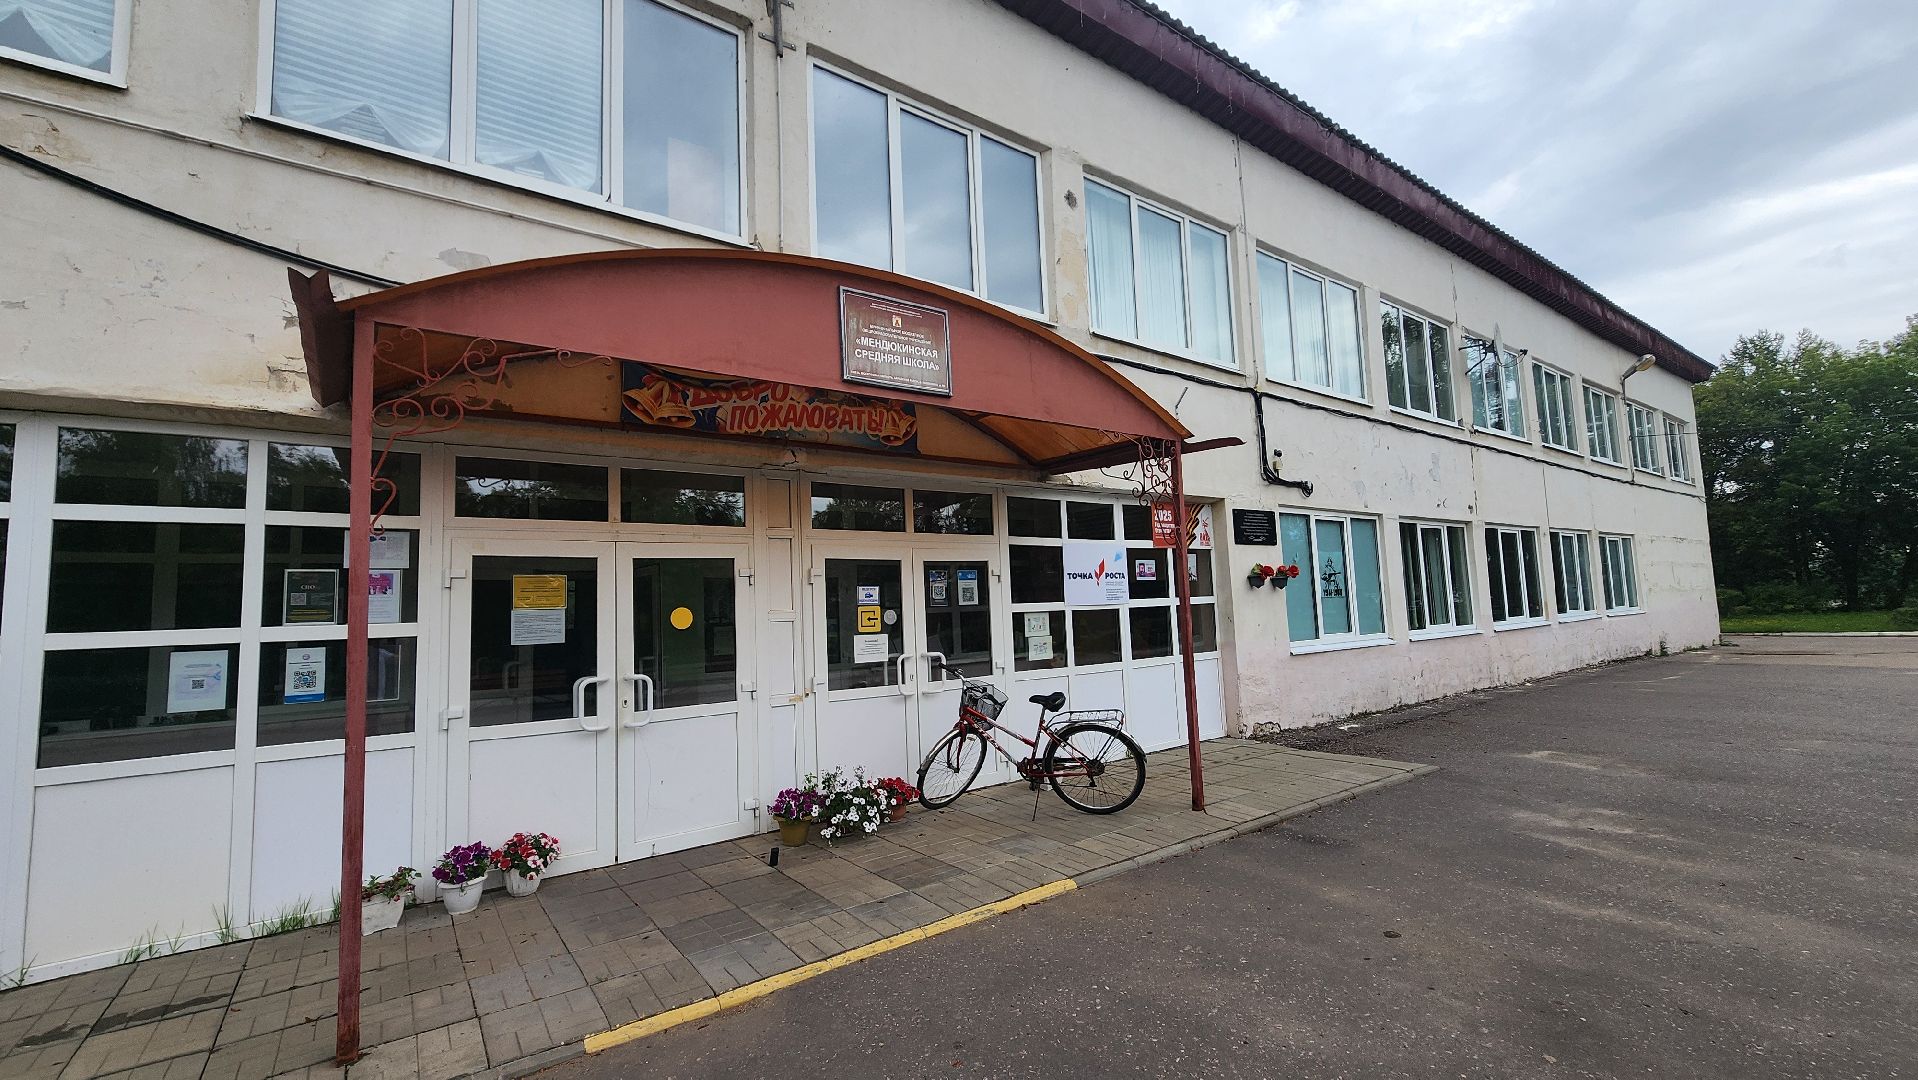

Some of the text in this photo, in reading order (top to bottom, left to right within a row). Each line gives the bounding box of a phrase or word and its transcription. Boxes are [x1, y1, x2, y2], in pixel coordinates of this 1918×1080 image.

[856, 336, 938, 359] «МЕНДЮКИНСКАЯ
[855, 348, 940, 371] СРЕДНЯЯ ШКОЛА»
[729, 403, 885, 433] ПОЖАЛОВАТЬ!
[1154, 509, 1172, 522] 2025
[1067, 572, 1126, 580] ТОЧКА РОСТА
